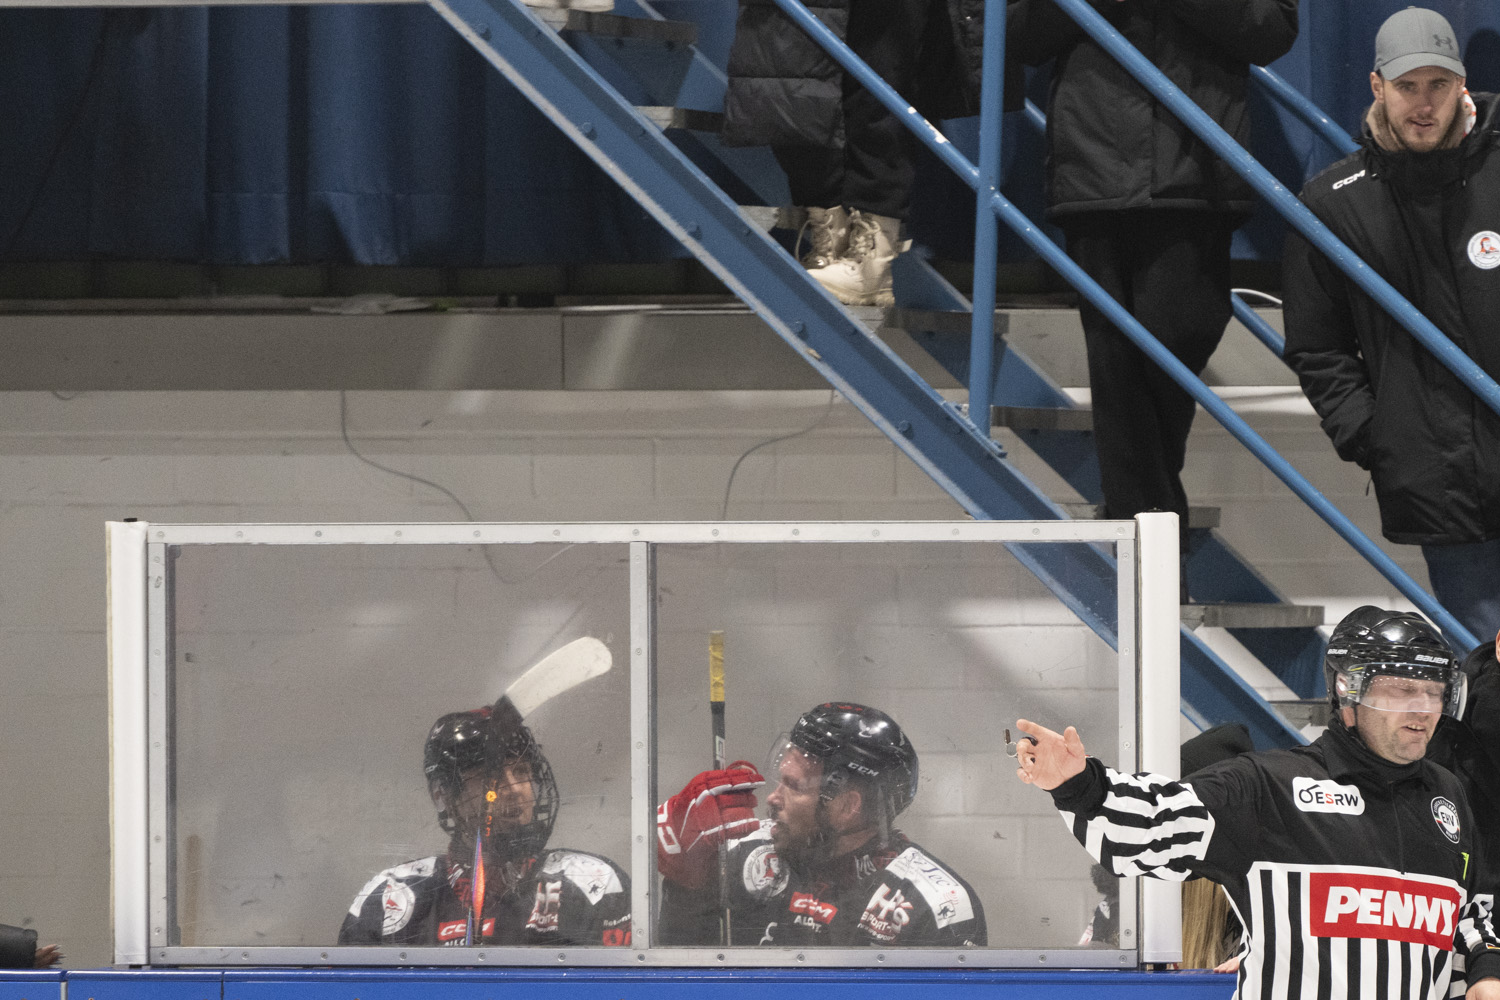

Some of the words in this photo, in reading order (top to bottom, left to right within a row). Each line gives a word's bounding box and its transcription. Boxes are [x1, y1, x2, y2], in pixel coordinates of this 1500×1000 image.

[1332, 169, 1366, 190] CCM
[1414, 654, 1450, 665] BAUER
[849, 761, 879, 777] CCM
[1324, 885, 1456, 937] PENNY
